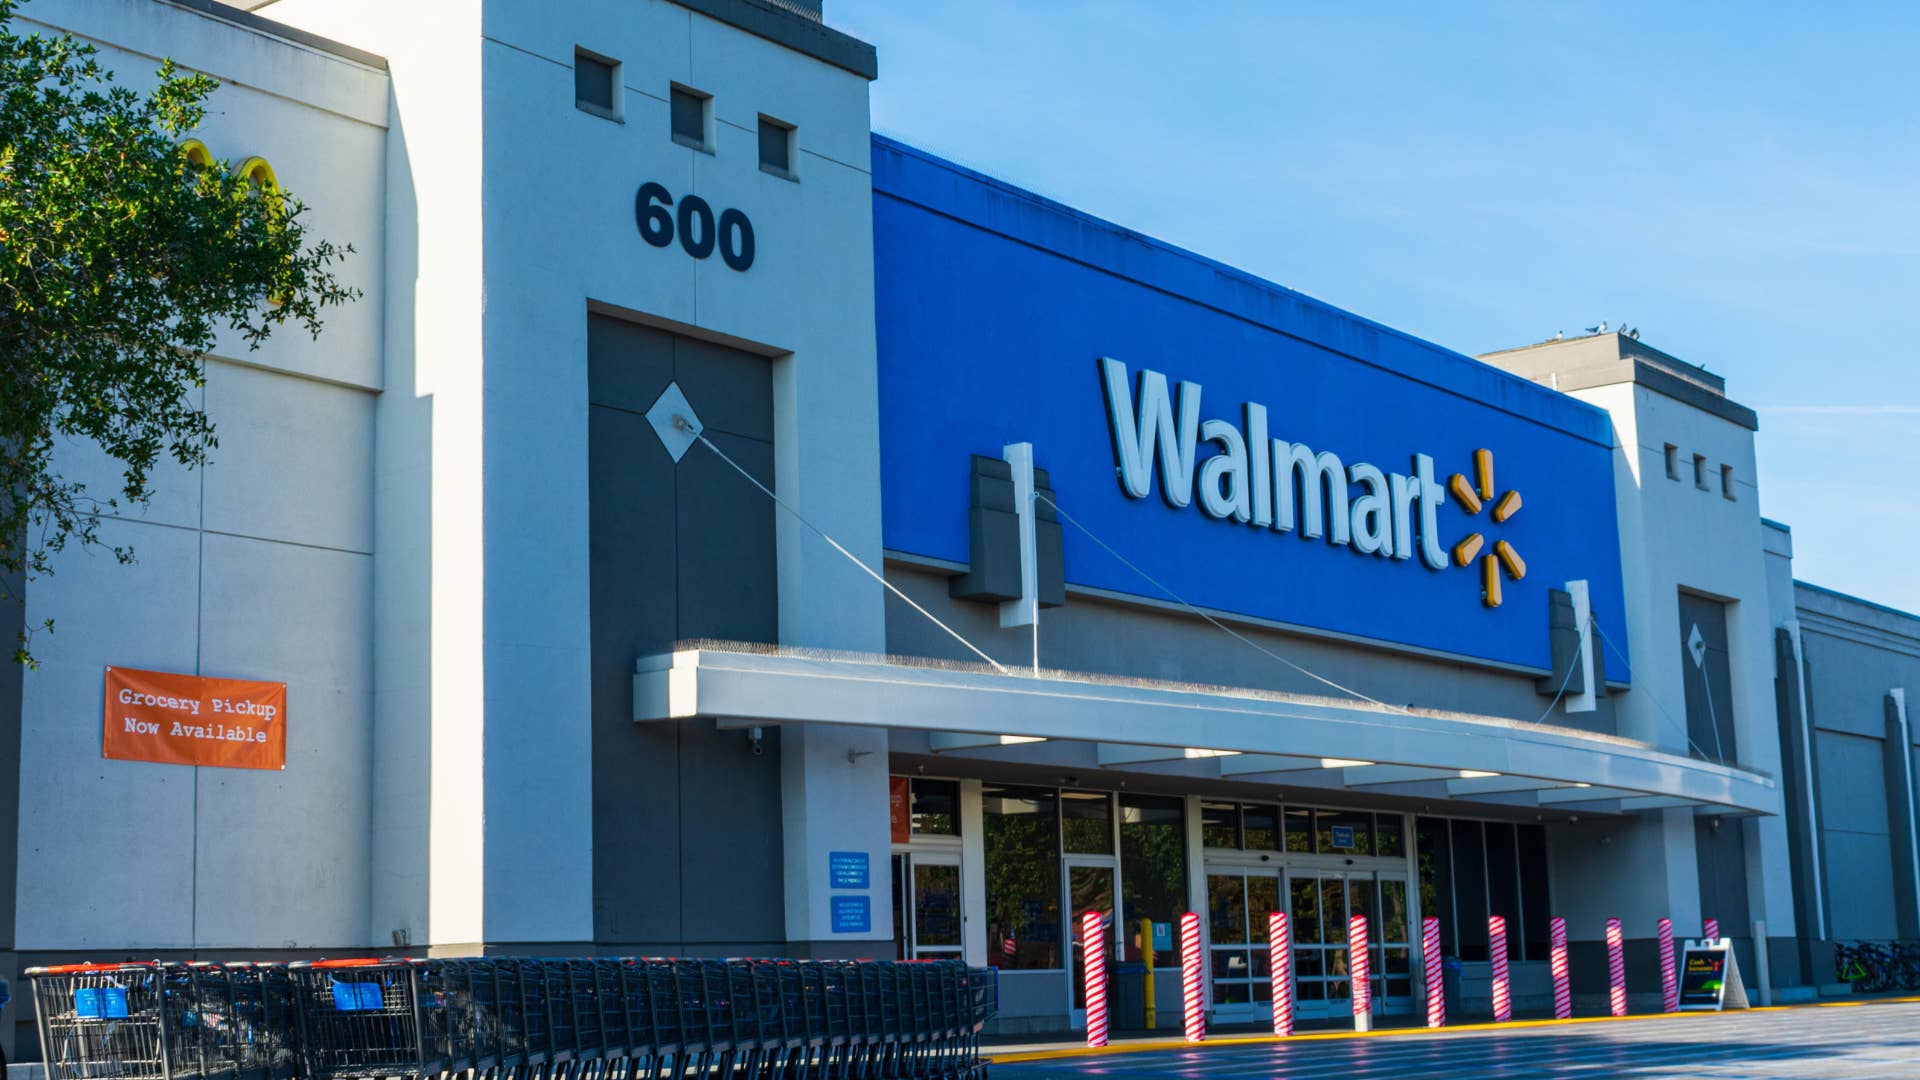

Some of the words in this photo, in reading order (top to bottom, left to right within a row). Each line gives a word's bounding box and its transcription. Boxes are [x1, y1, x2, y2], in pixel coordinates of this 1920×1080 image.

[635, 181, 755, 272] 600
[1100, 356, 1449, 570] Walmart
[119, 688, 200, 715] Grocery
[212, 698, 276, 720] Pickup
[124, 717, 160, 735] Now
[170, 721, 267, 743] Available
